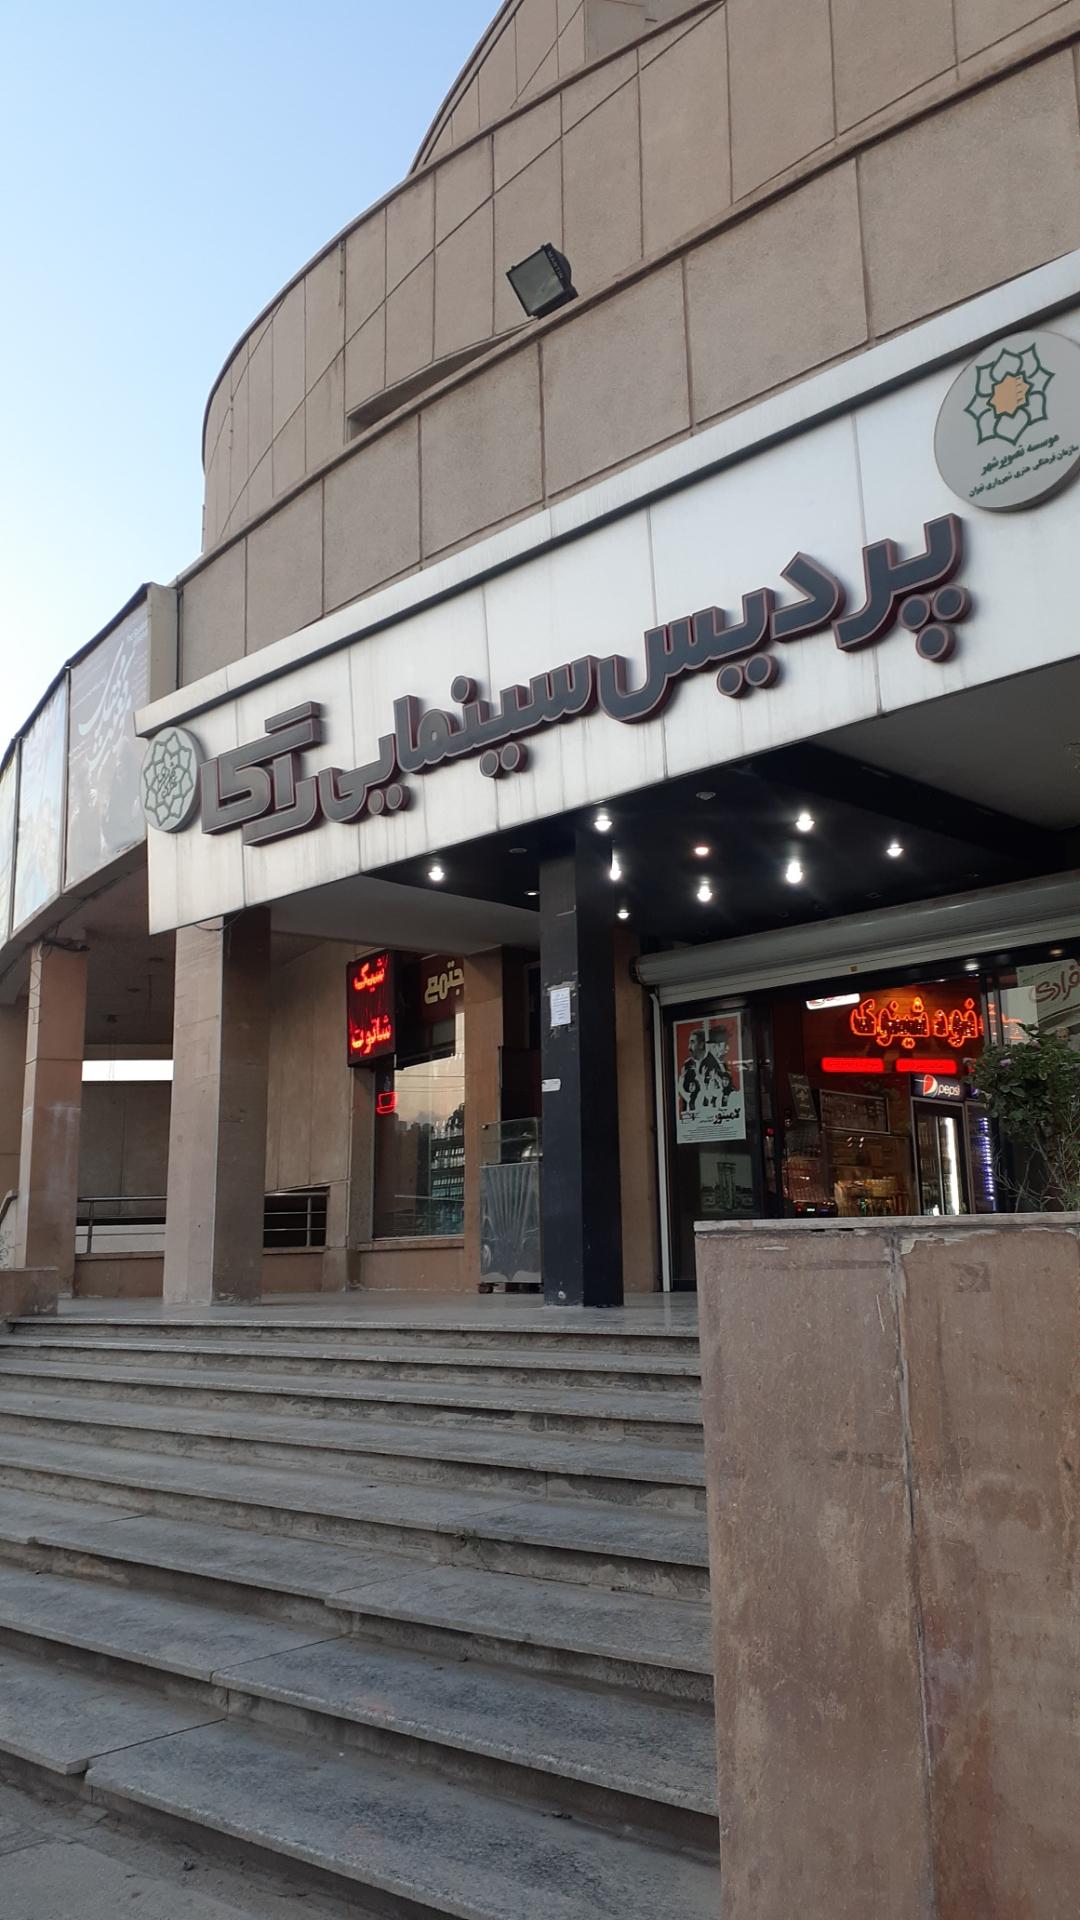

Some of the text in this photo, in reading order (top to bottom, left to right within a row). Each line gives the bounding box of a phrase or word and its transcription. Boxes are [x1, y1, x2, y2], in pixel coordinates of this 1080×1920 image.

[981, 456, 999, 476] شهر
[1026, 434, 1060, 452] موسسه
[968, 444, 1079, 498] سازمان فرهنگی هنری شهرداری تهران
[599, 513, 971, 724] پردیس
[317, 655, 601, 825] سینمایی
[424, 960, 464, 1004] جتمع
[933, 998, 978, 1047] فود
[937, 1084, 961, 1097] pepsi
